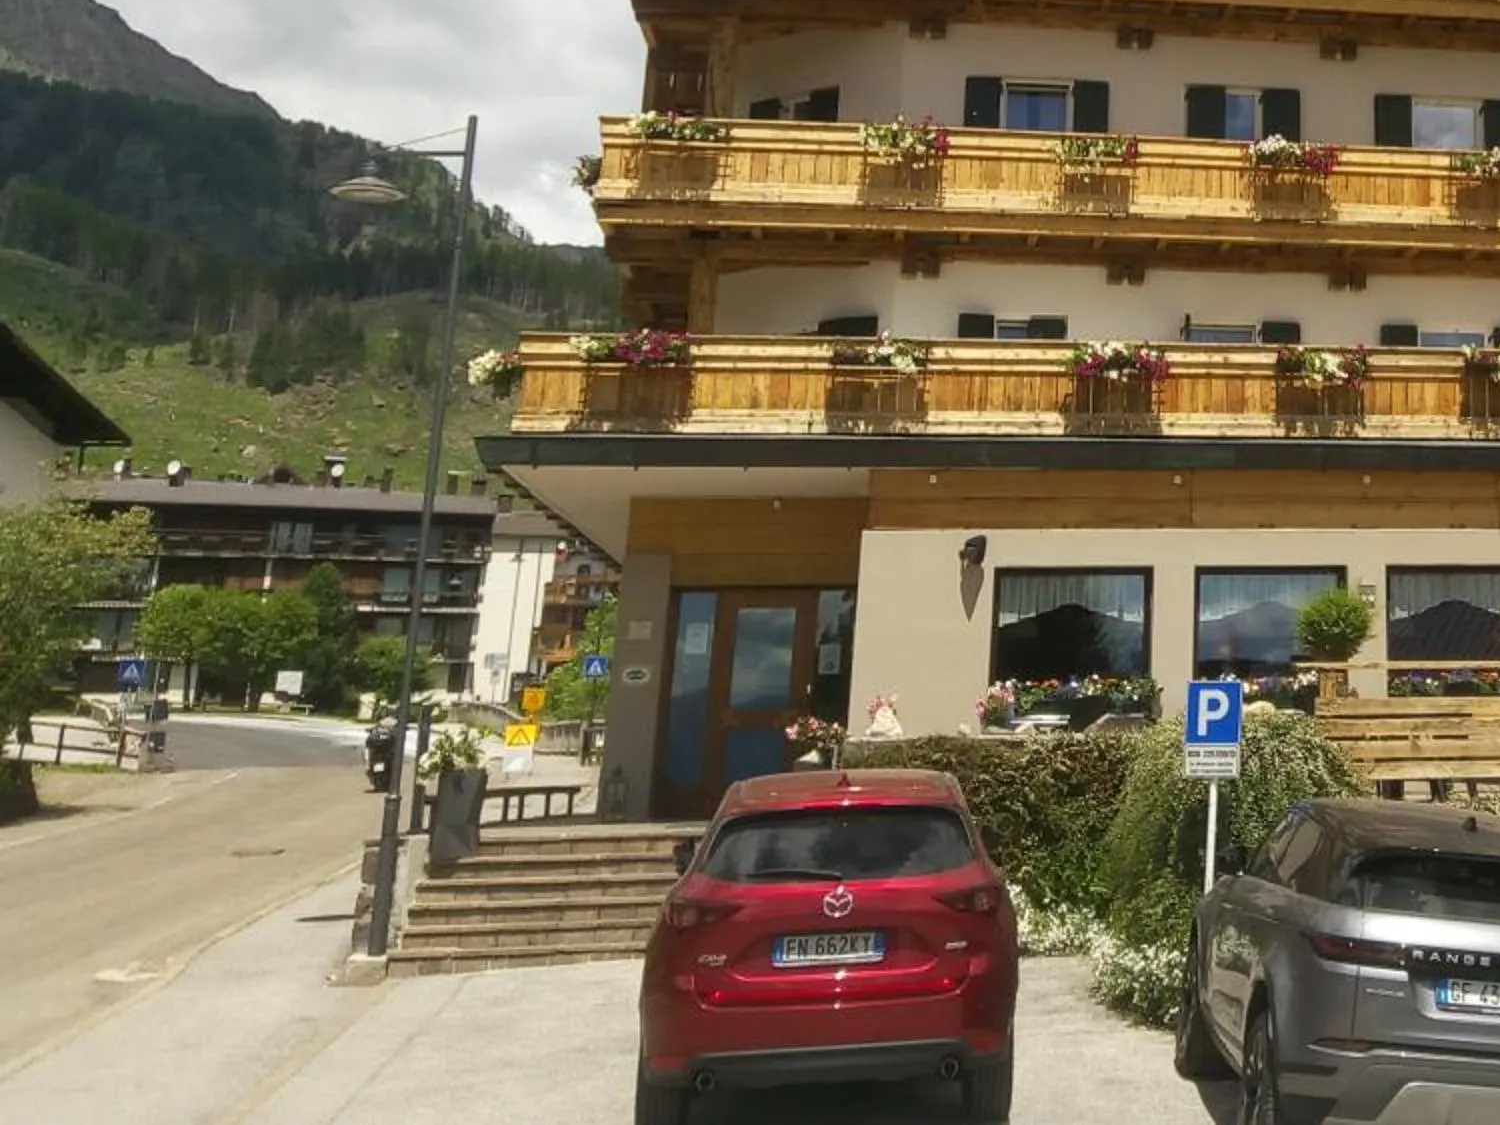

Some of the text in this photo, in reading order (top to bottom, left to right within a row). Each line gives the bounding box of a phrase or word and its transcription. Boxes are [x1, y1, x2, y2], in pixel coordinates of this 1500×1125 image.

[1197, 688, 1230, 737] P
[786, 938, 809, 959] FN
[1411, 948, 1492, 967] RANGE
